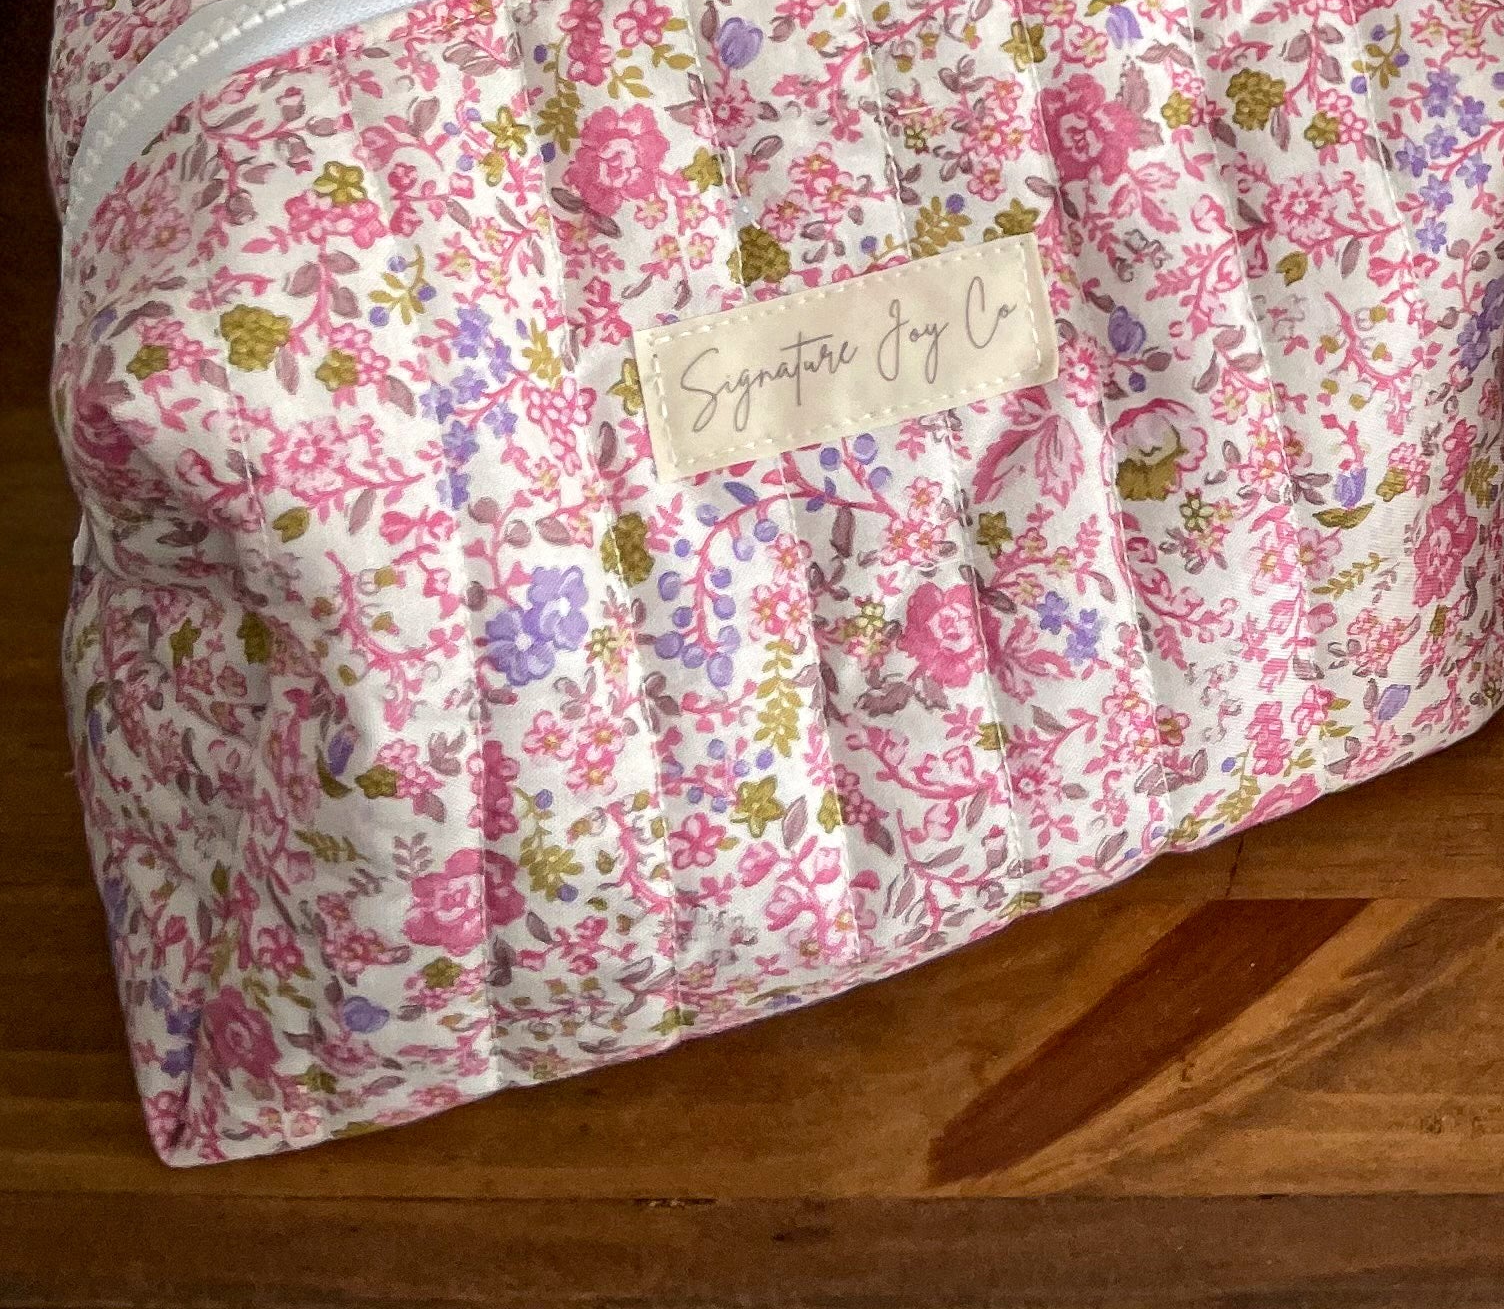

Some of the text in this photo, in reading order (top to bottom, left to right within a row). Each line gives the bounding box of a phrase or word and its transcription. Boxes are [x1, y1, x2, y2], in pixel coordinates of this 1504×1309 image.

[681, 275, 1018, 433] Signature Joy Co
